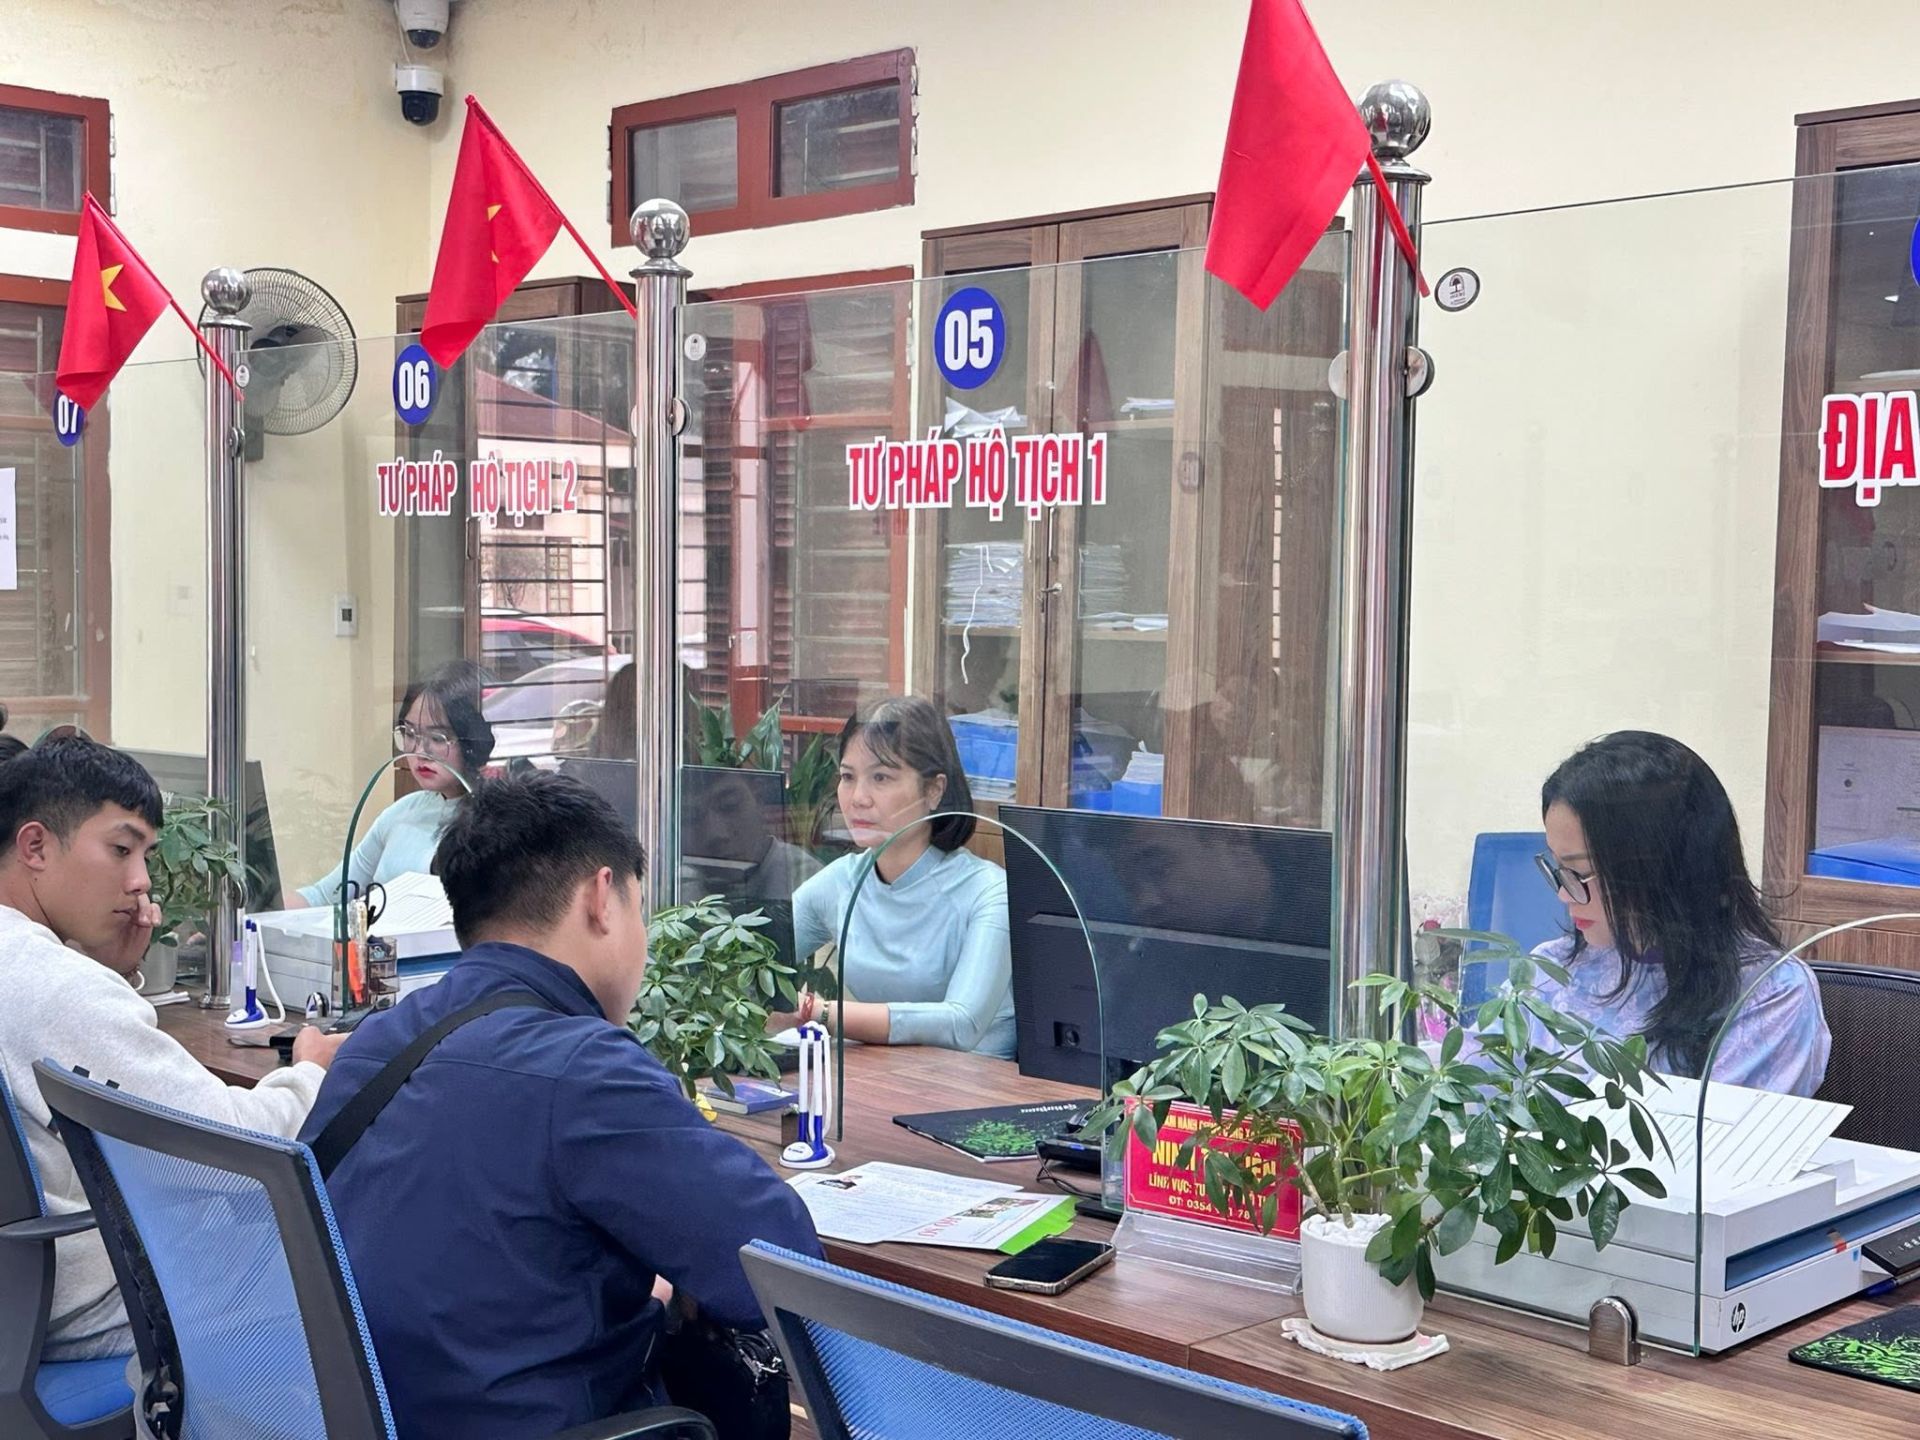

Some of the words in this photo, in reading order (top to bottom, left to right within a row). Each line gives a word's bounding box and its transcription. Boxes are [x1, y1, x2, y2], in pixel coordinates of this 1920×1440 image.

[943, 306, 995, 371] 05
[397, 359, 431, 410] 06
[849, 438, 884, 507] TƯ
[887, 427, 960, 505] PHÁP
[968, 427, 1006, 518] HỘ
[1014, 438, 1081, 518] TỊCH
[1091, 438, 1105, 503] 1
[1822, 395, 1918, 501] ĐỊA
[376, 458, 403, 513] TƯ
[405, 451, 457, 513] PHÁP
[471, 450, 499, 526] HỘ
[504, 460, 551, 526] TỊCH
[562, 459, 576, 512] 2
